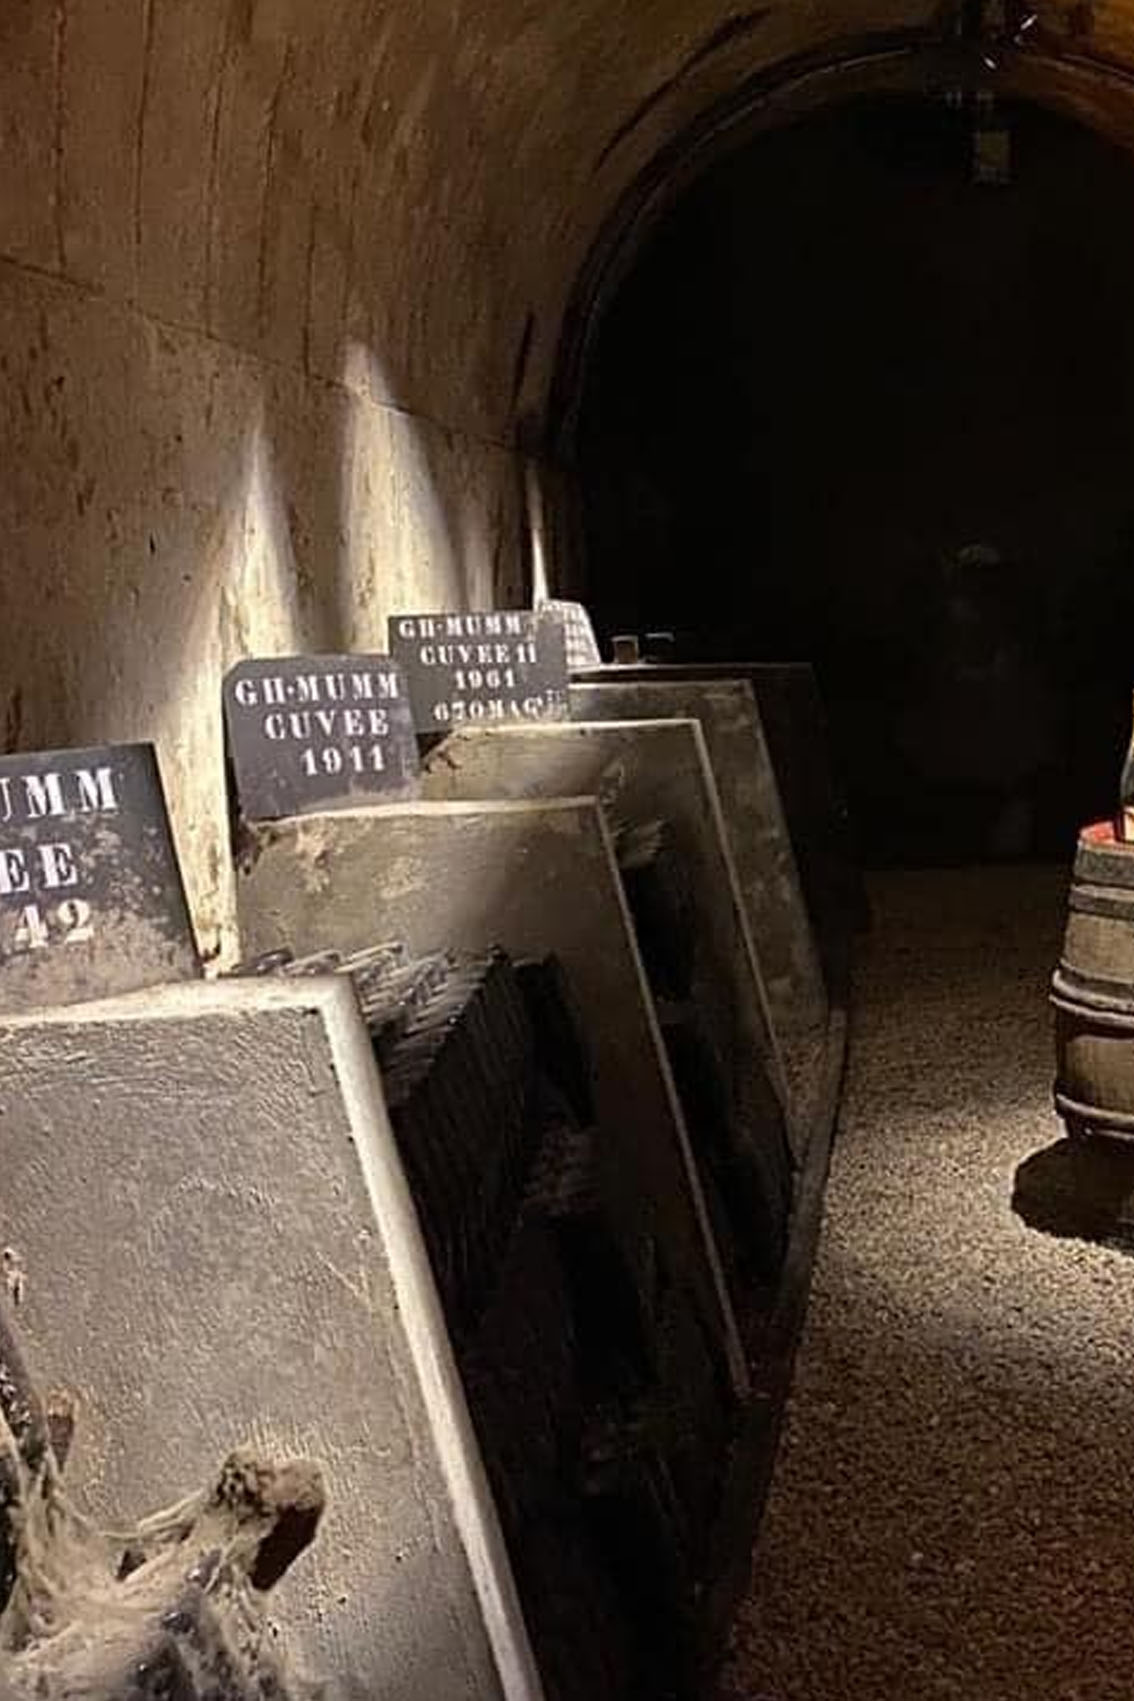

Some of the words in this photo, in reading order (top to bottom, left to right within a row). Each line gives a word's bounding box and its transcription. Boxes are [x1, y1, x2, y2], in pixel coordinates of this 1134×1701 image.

[420, 643, 510, 665] CUVEE
[454, 667, 516, 690] 1961
[264, 708, 390, 740] CUVEE
[302, 744, 386, 776] 1911
